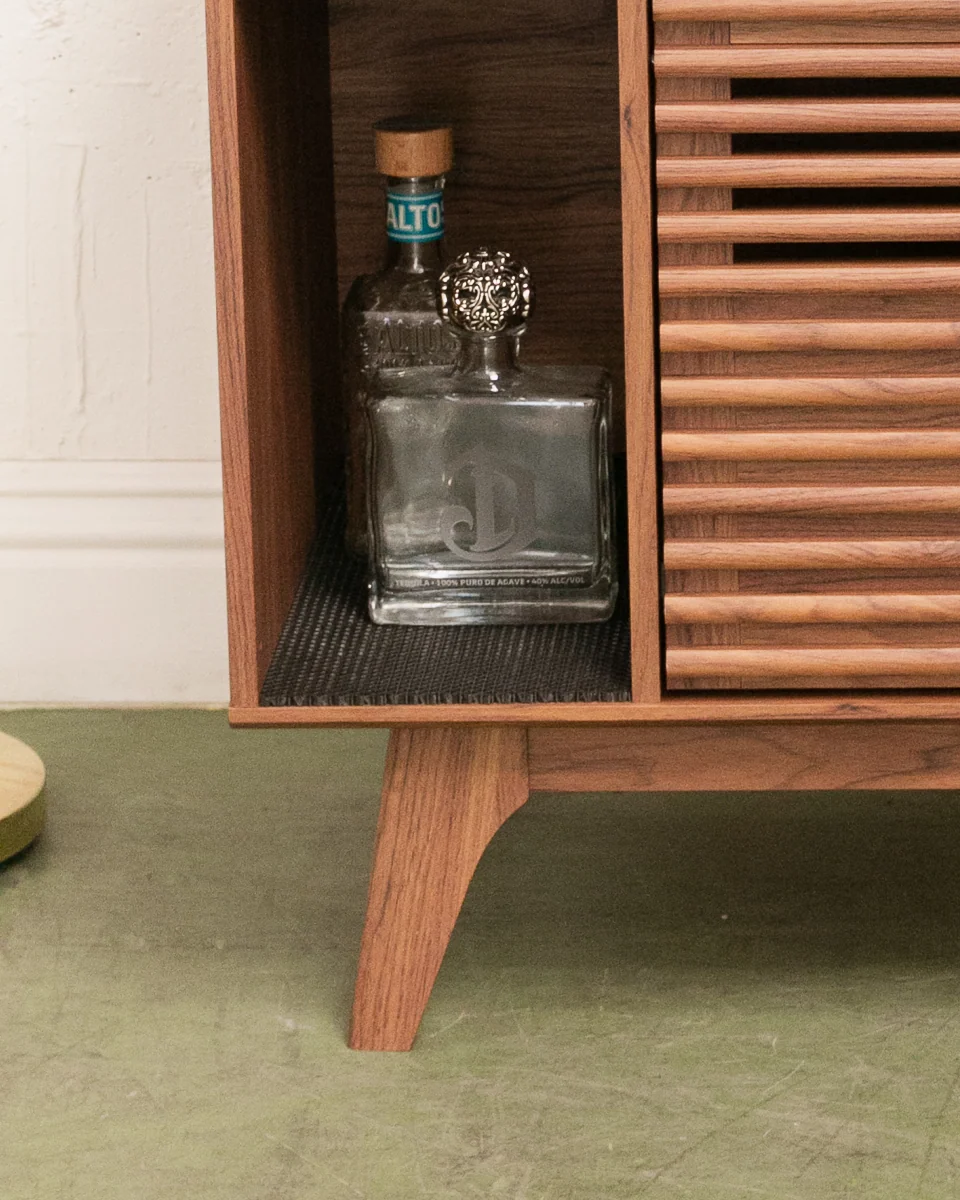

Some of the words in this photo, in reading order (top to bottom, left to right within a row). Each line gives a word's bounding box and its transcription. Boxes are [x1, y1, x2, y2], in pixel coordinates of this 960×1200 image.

[387, 202, 443, 231] ALTO
[436, 579, 458, 587] 100%
[460, 579, 483, 587] PURO
[497, 578, 525, 586] AGAVE
[550, 576, 585, 585] ALC/VOL
